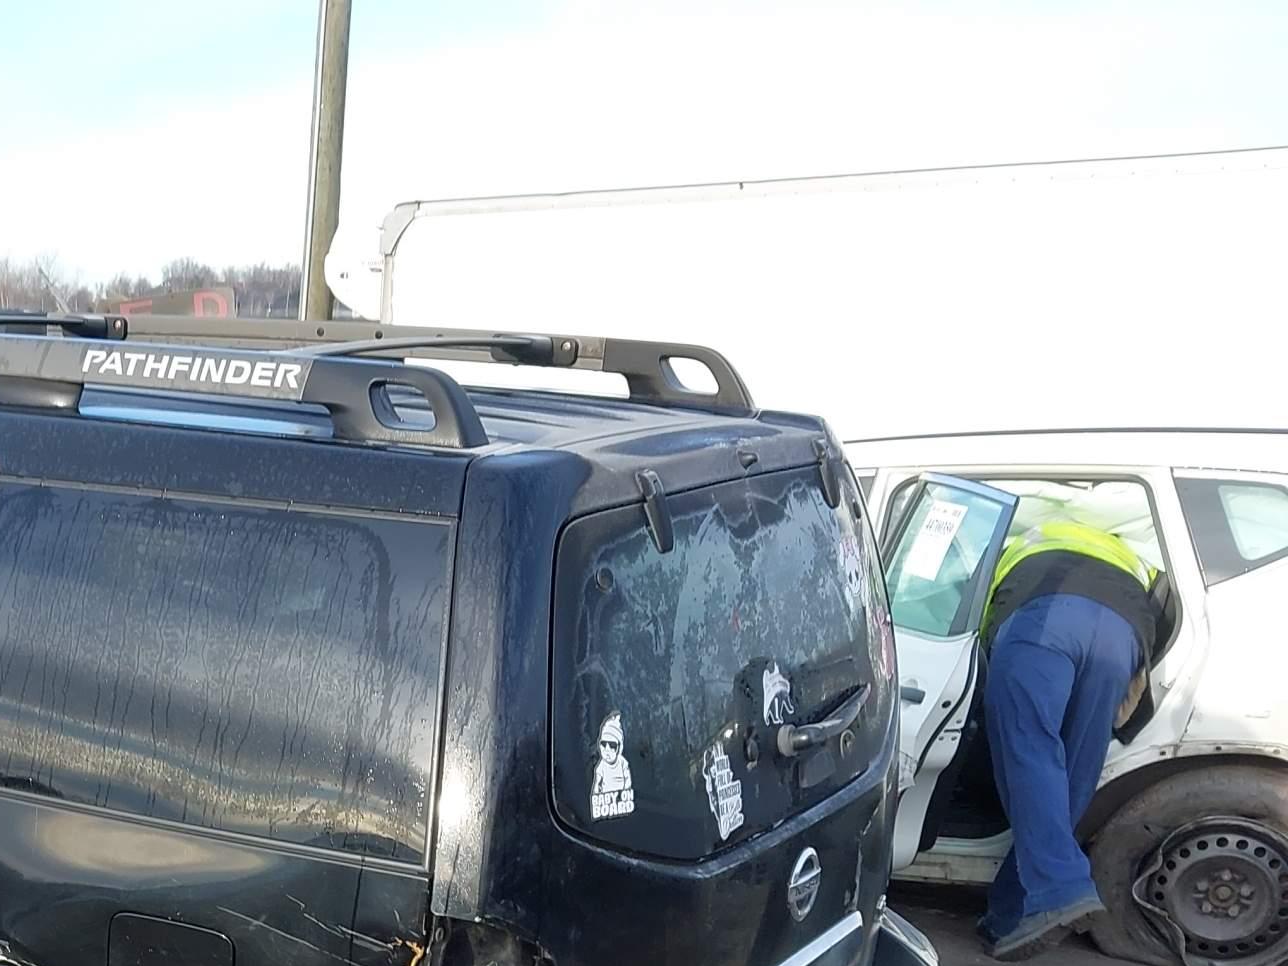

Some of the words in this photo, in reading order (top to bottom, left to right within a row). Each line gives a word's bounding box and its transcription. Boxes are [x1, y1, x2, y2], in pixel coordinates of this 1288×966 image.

[81, 349, 302, 389] PATHFINDER
[591, 791, 619, 806] BABY
[620, 788, 635, 802] ON
[592, 800, 635, 819] BOARD
